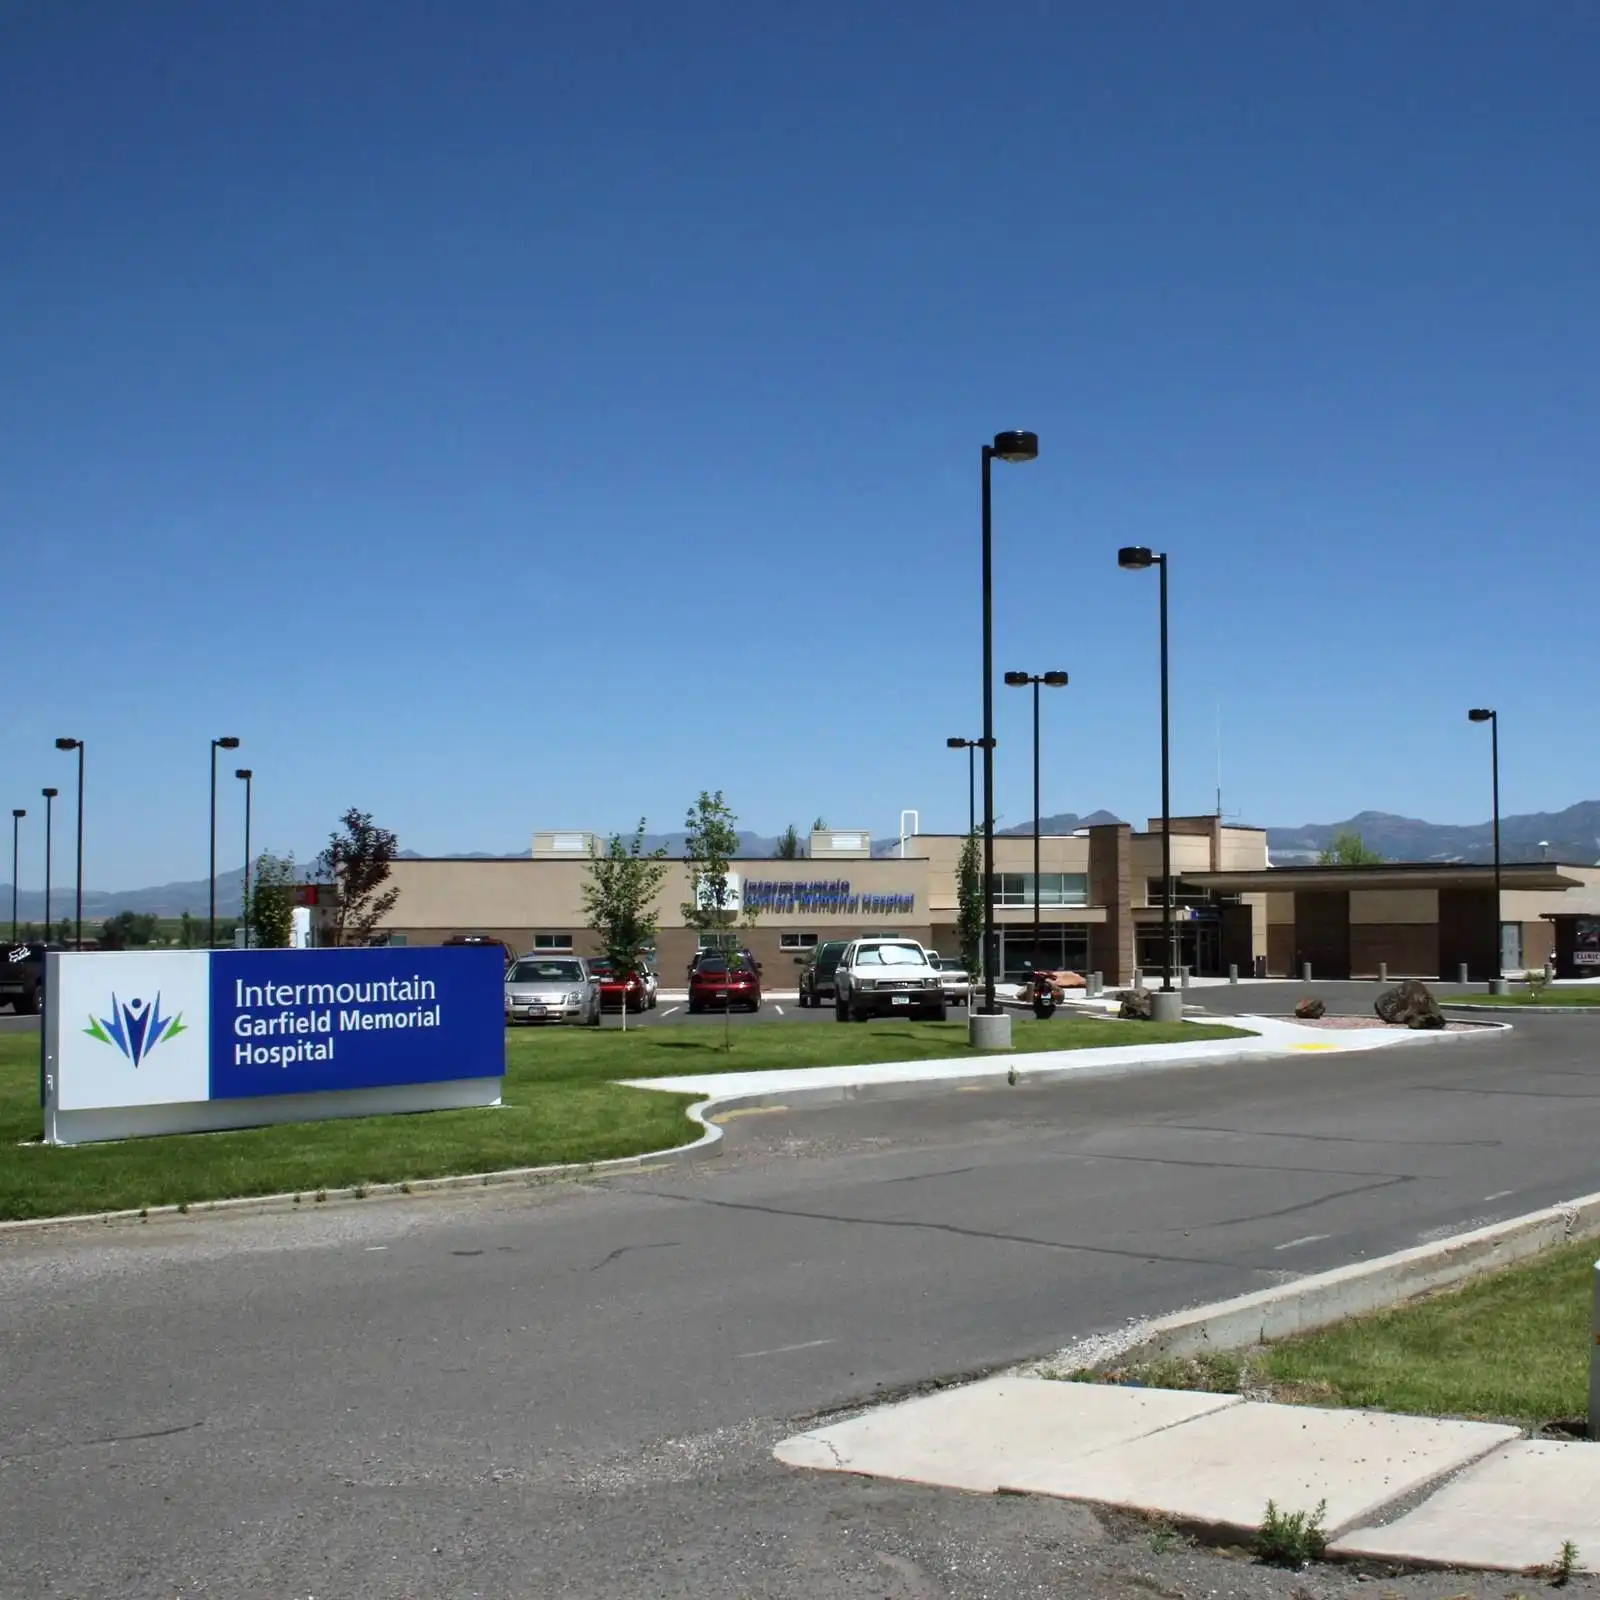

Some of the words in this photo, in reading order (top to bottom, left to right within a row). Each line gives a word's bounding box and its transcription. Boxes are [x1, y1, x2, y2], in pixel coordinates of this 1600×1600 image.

[235, 974, 437, 1009] Intermountain
[234, 1010, 331, 1037] Garfield
[338, 1004, 441, 1032] Memorial
[234, 1037, 335, 1068] Hospital
